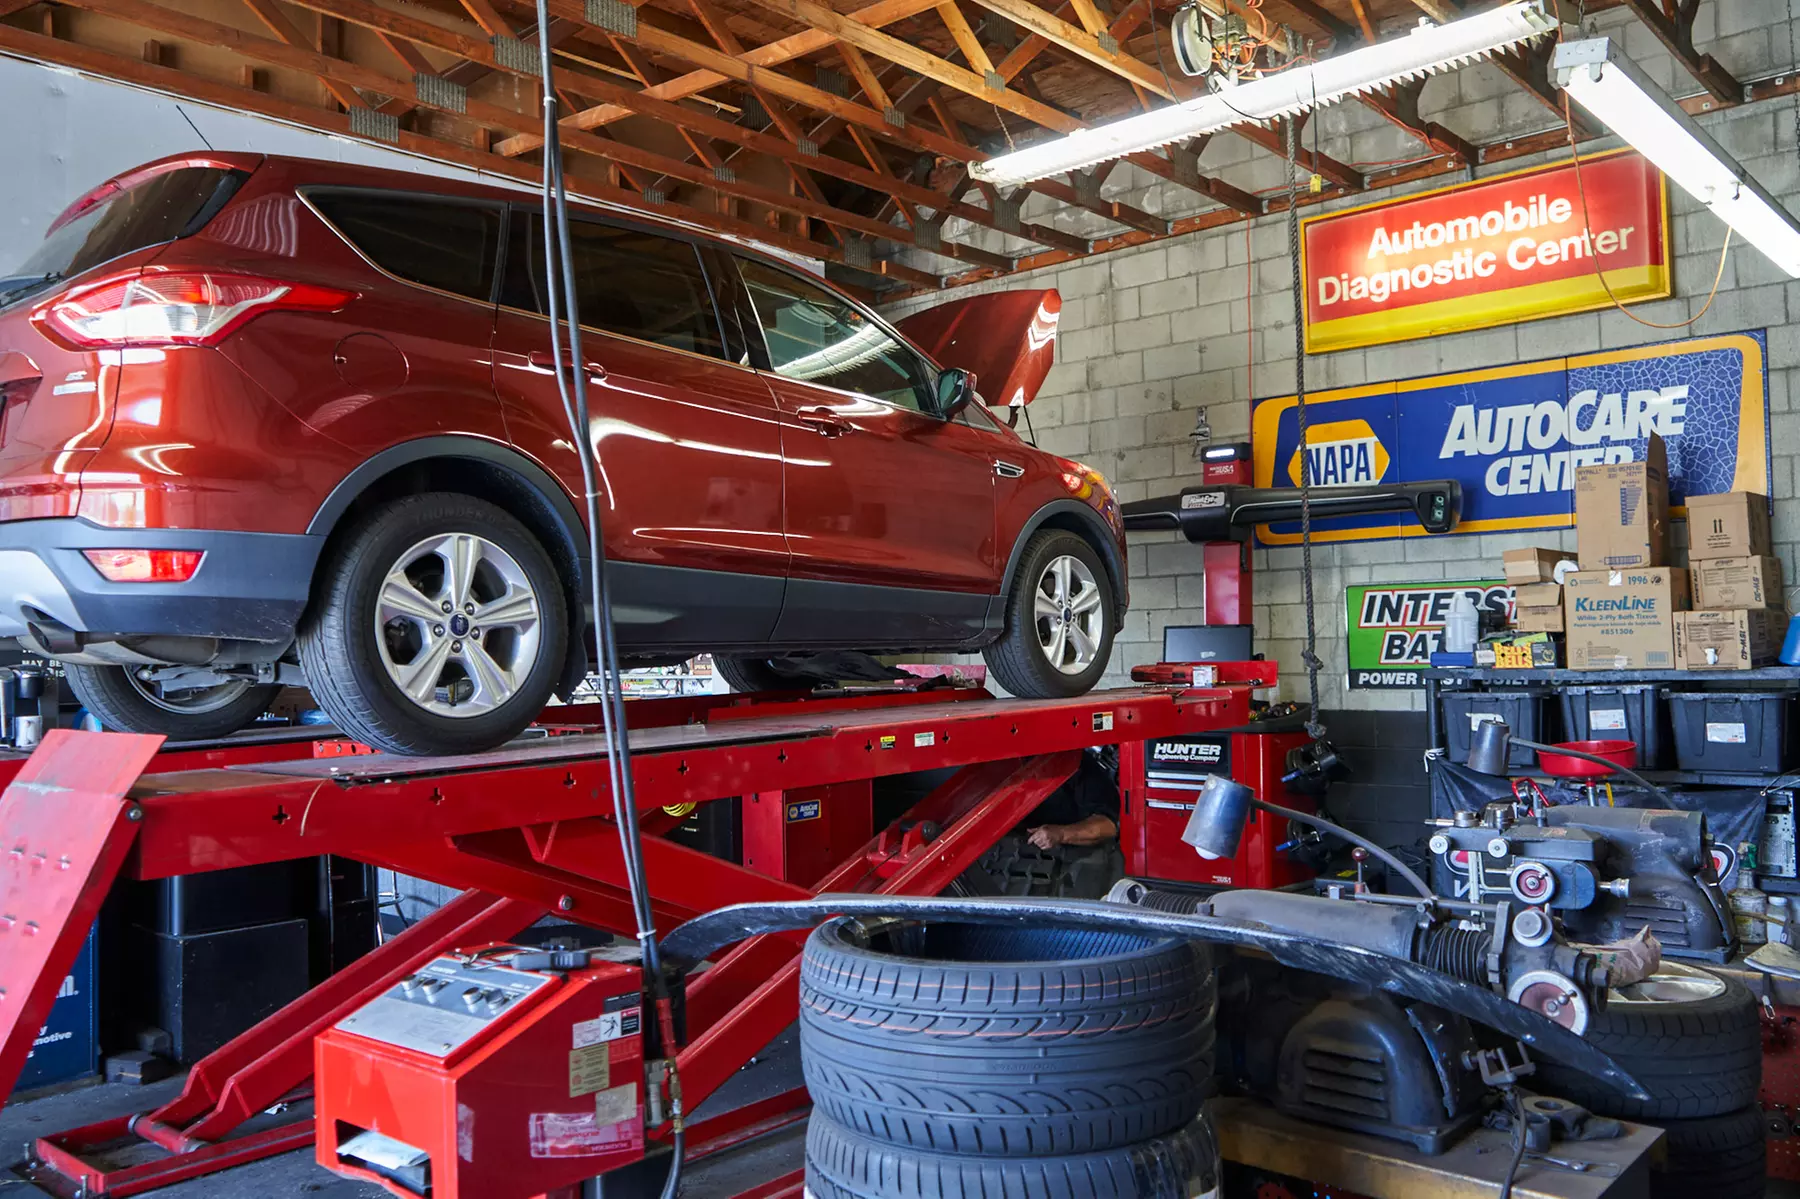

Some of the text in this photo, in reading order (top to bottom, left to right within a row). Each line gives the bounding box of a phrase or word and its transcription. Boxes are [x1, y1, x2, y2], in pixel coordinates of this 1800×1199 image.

[1367, 193, 1572, 260] Automobile
[1318, 226, 1635, 306] Diagnostic Center
[1439, 384, 1690, 459] AUTOCARE
[1307, 442, 1372, 486] NAPA
[1628, 575, 1648, 585] 1996
[1361, 587, 1517, 625] INTES
[1358, 672, 1418, 685] POWER
[1153, 753, 1220, 762] Engineering Company
[1154, 743, 1221, 755] HUNTER
